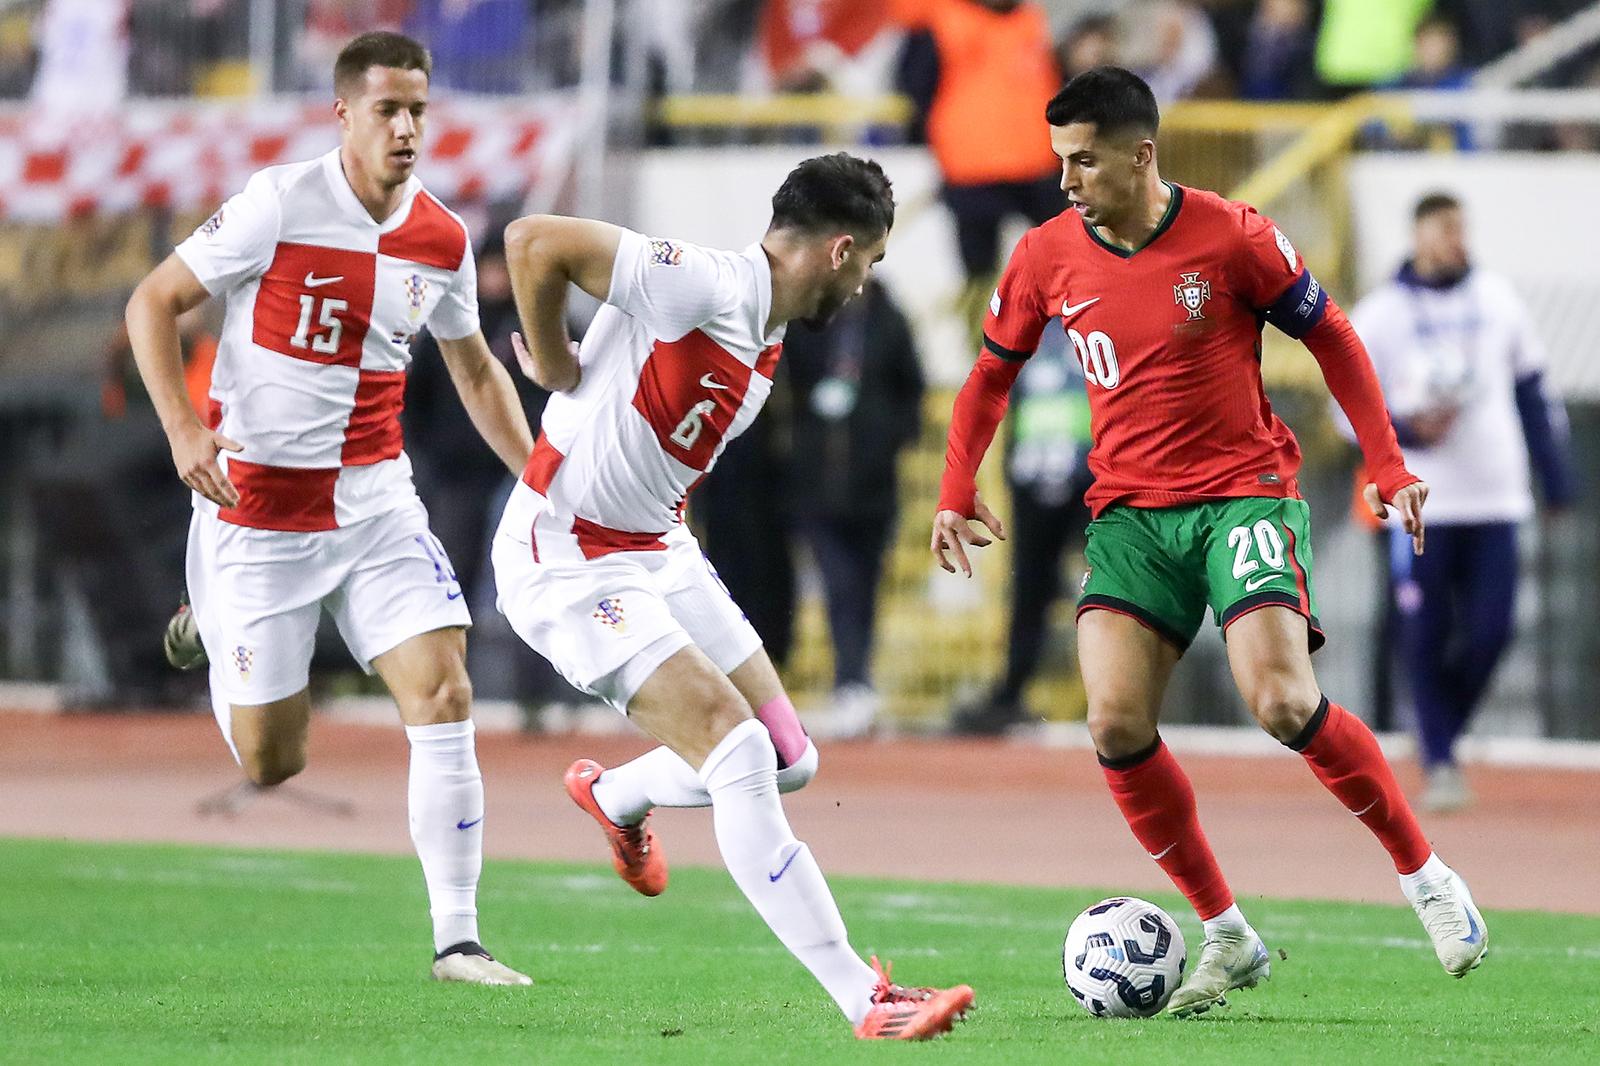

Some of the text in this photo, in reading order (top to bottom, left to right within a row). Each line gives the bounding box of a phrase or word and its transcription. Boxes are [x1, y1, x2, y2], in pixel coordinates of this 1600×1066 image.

[290, 294, 348, 354] 15
[1067, 328, 1120, 389] 20
[670, 400, 716, 450] 6
[1228, 519, 1285, 579] 20
